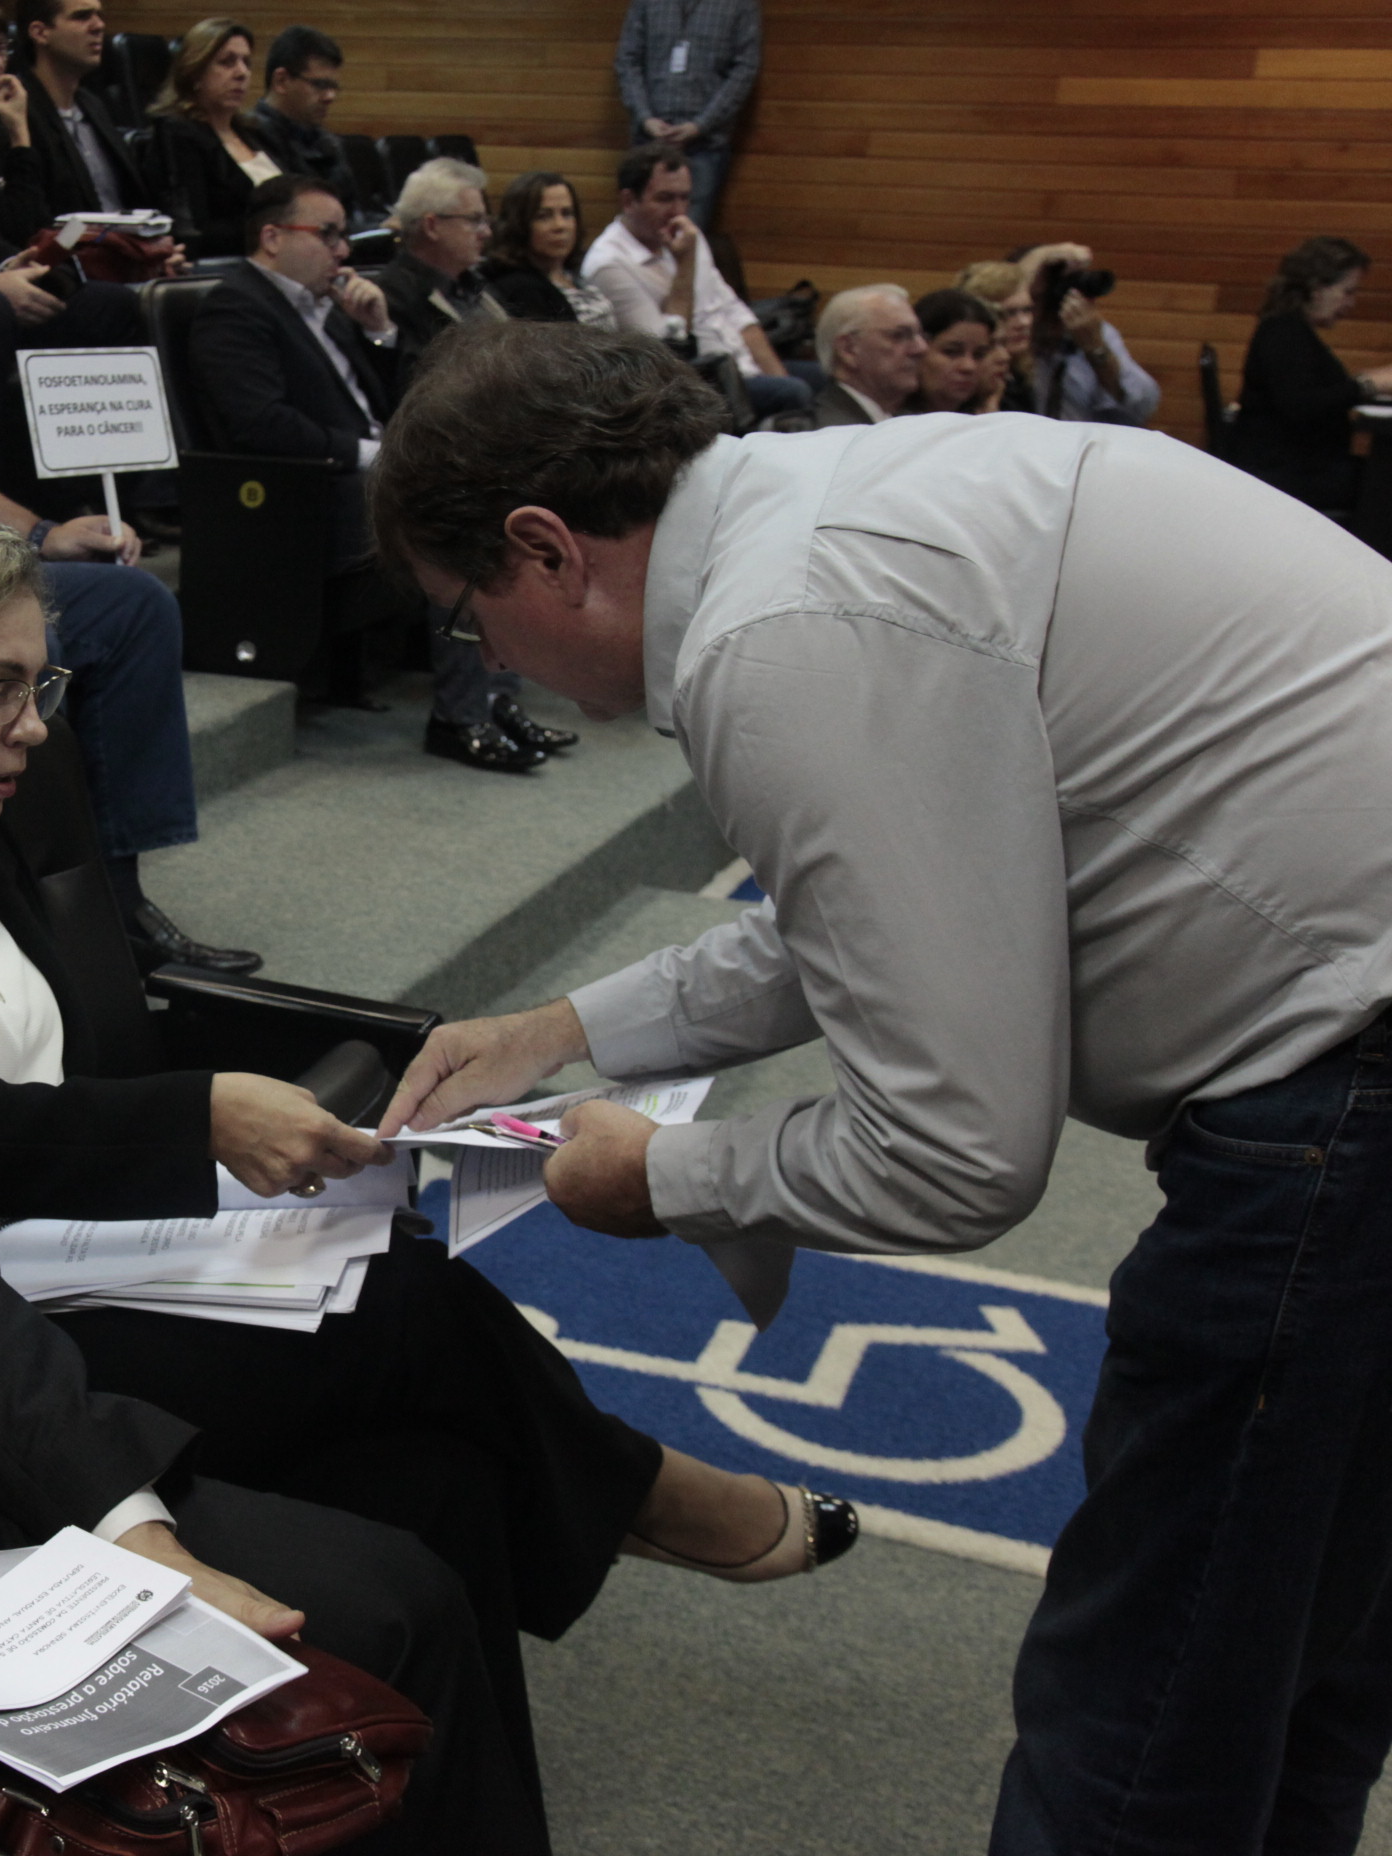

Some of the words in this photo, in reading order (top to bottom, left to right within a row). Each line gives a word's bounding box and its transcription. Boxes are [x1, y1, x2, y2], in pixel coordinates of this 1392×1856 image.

[39, 404, 46, 416] A
[49, 401, 106, 415] ESPERANÇA
[109, 400, 126, 411] NA
[127, 399, 152, 411] CURA
[56, 424, 84, 437] PARA
[87, 423, 95, 435] O
[55, 1609, 67, 1617] DA
[17, 1618, 55, 1646] COMISSÃO
[94, 1649, 137, 1686] sobre
[82, 1683, 95, 1696] a
[94, 1662, 164, 1713] Relatório
[196, 1672, 225, 1694] 2016
[9, 1690, 83, 1723] prestação
[19, 1707, 98, 1736] financeiro
